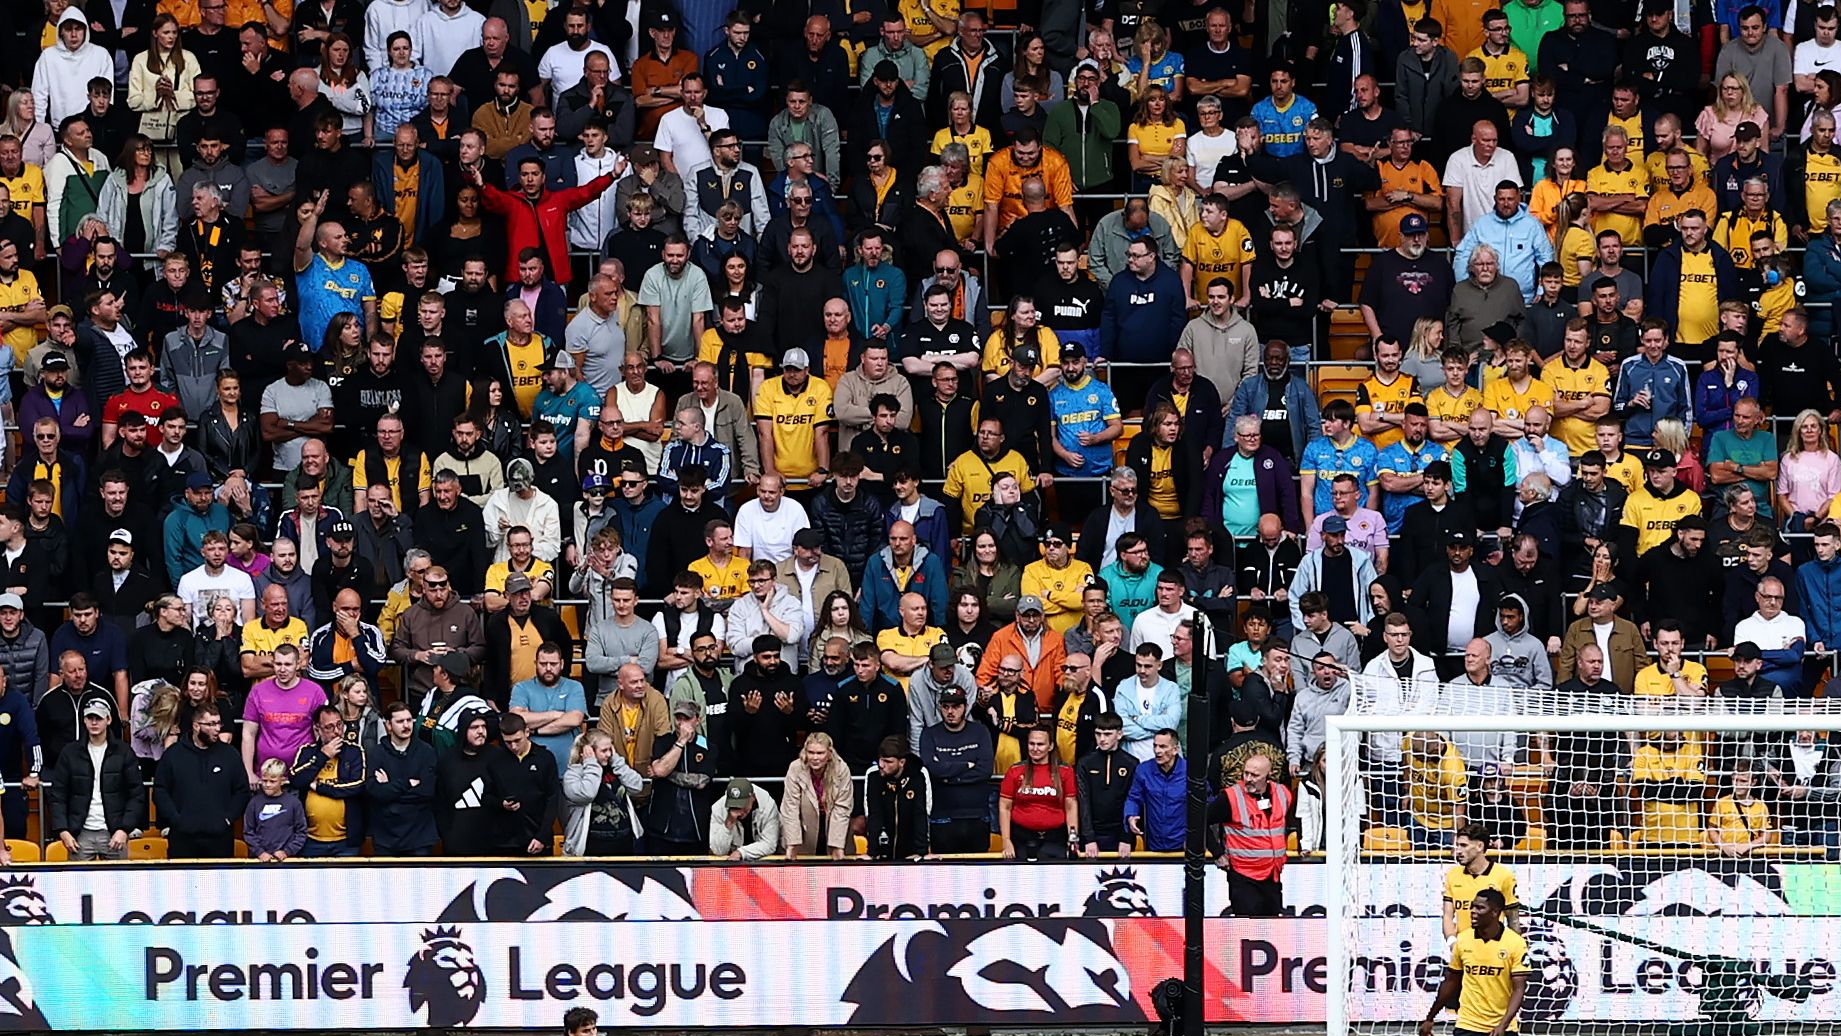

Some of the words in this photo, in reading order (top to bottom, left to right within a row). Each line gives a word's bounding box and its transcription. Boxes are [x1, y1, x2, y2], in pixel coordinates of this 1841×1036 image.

[1189, 20, 1207, 29] BOS
[1484, 78, 1514, 88] EBET
[380, 91, 419, 102] AstroPay
[1265, 132, 1300, 144] DEBET
[9, 201, 31, 211] BET
[948, 205, 975, 215] BET
[1198, 262, 1236, 273] DEBET
[1680, 274, 1716, 284] DEBET
[1053, 305, 1083, 318] PUMA
[513, 376, 544, 387] EBET
[588, 405, 601, 416] 12
[1262, 409, 1288, 420] EBET
[776, 413, 815, 425] DEBET
[1060, 410, 1100, 425] DEBET
[1150, 470, 1173, 480] DEB
[1230, 478, 1257, 487] DEBE
[1646, 520, 1677, 531] DEBE
[1118, 598, 1148, 608] SUDU
[1017, 786, 1057, 798] AstroPa
[1240, 938, 1450, 993] Premie
[1464, 964, 1505, 977] DEBET
[145, 946, 384, 1001] Premier
[508, 946, 747, 1017] League
